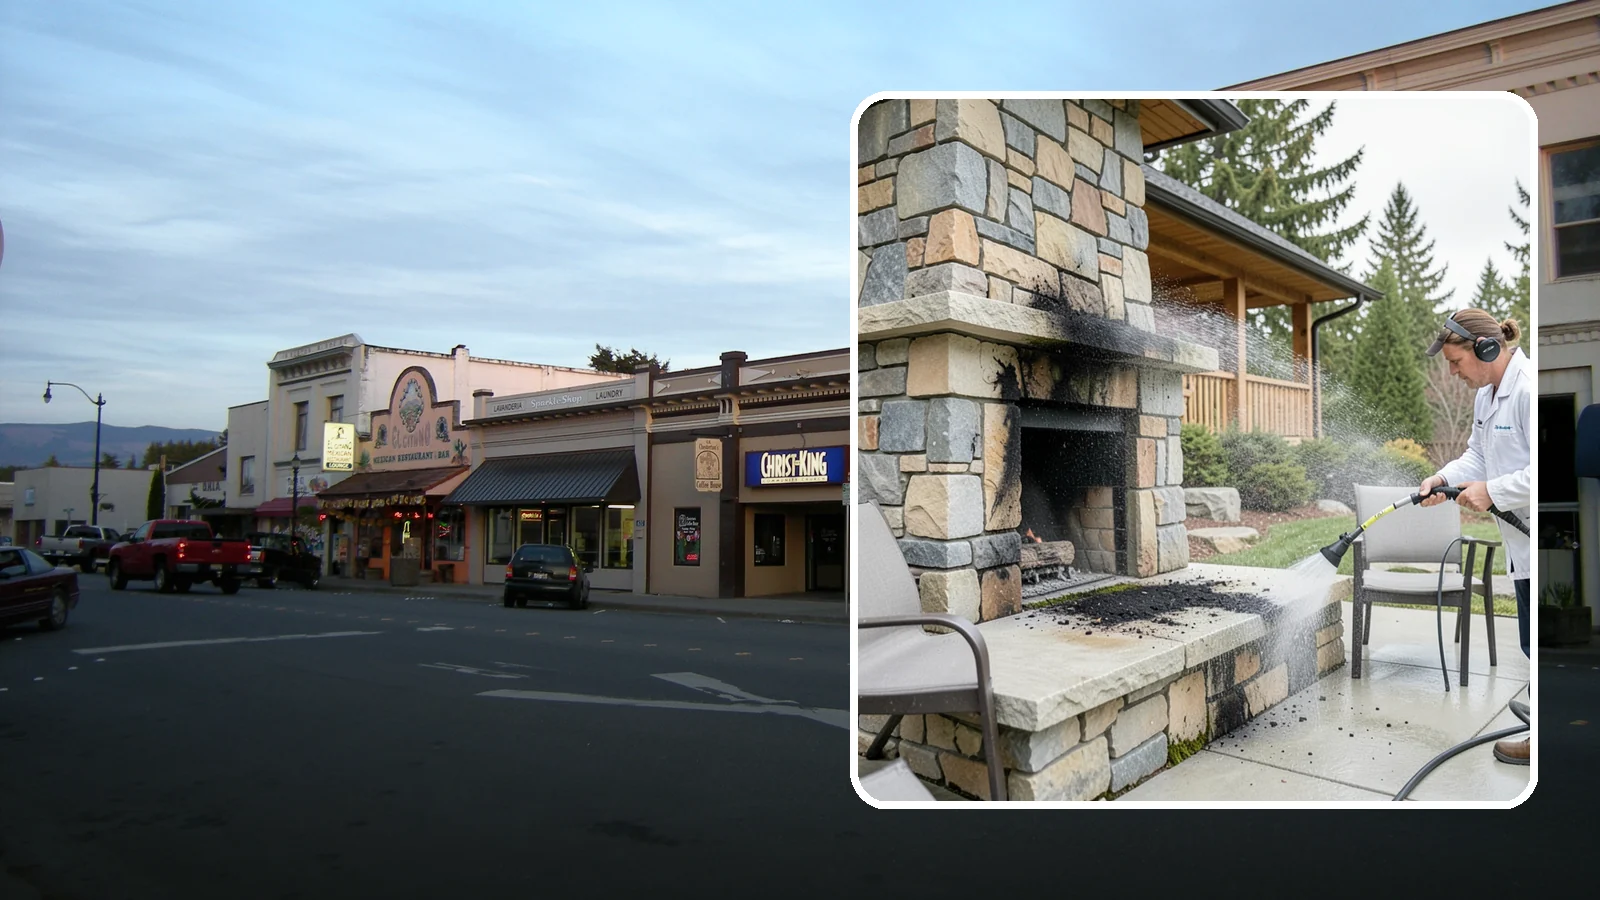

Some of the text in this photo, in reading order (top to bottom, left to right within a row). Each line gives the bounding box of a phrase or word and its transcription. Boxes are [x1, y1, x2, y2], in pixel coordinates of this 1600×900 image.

[530, 394, 582, 409] Sparkle Shop
[595, 389, 623, 400] LAUNDRY
[493, 402, 523, 413] LAVANDERIA
[373, 455, 396, 464] MEXICAN
[397, 451, 433, 462] RESTAURANT
[438, 450, 450, 459] BAR
[760, 450, 827, 478] CHRIST KING
